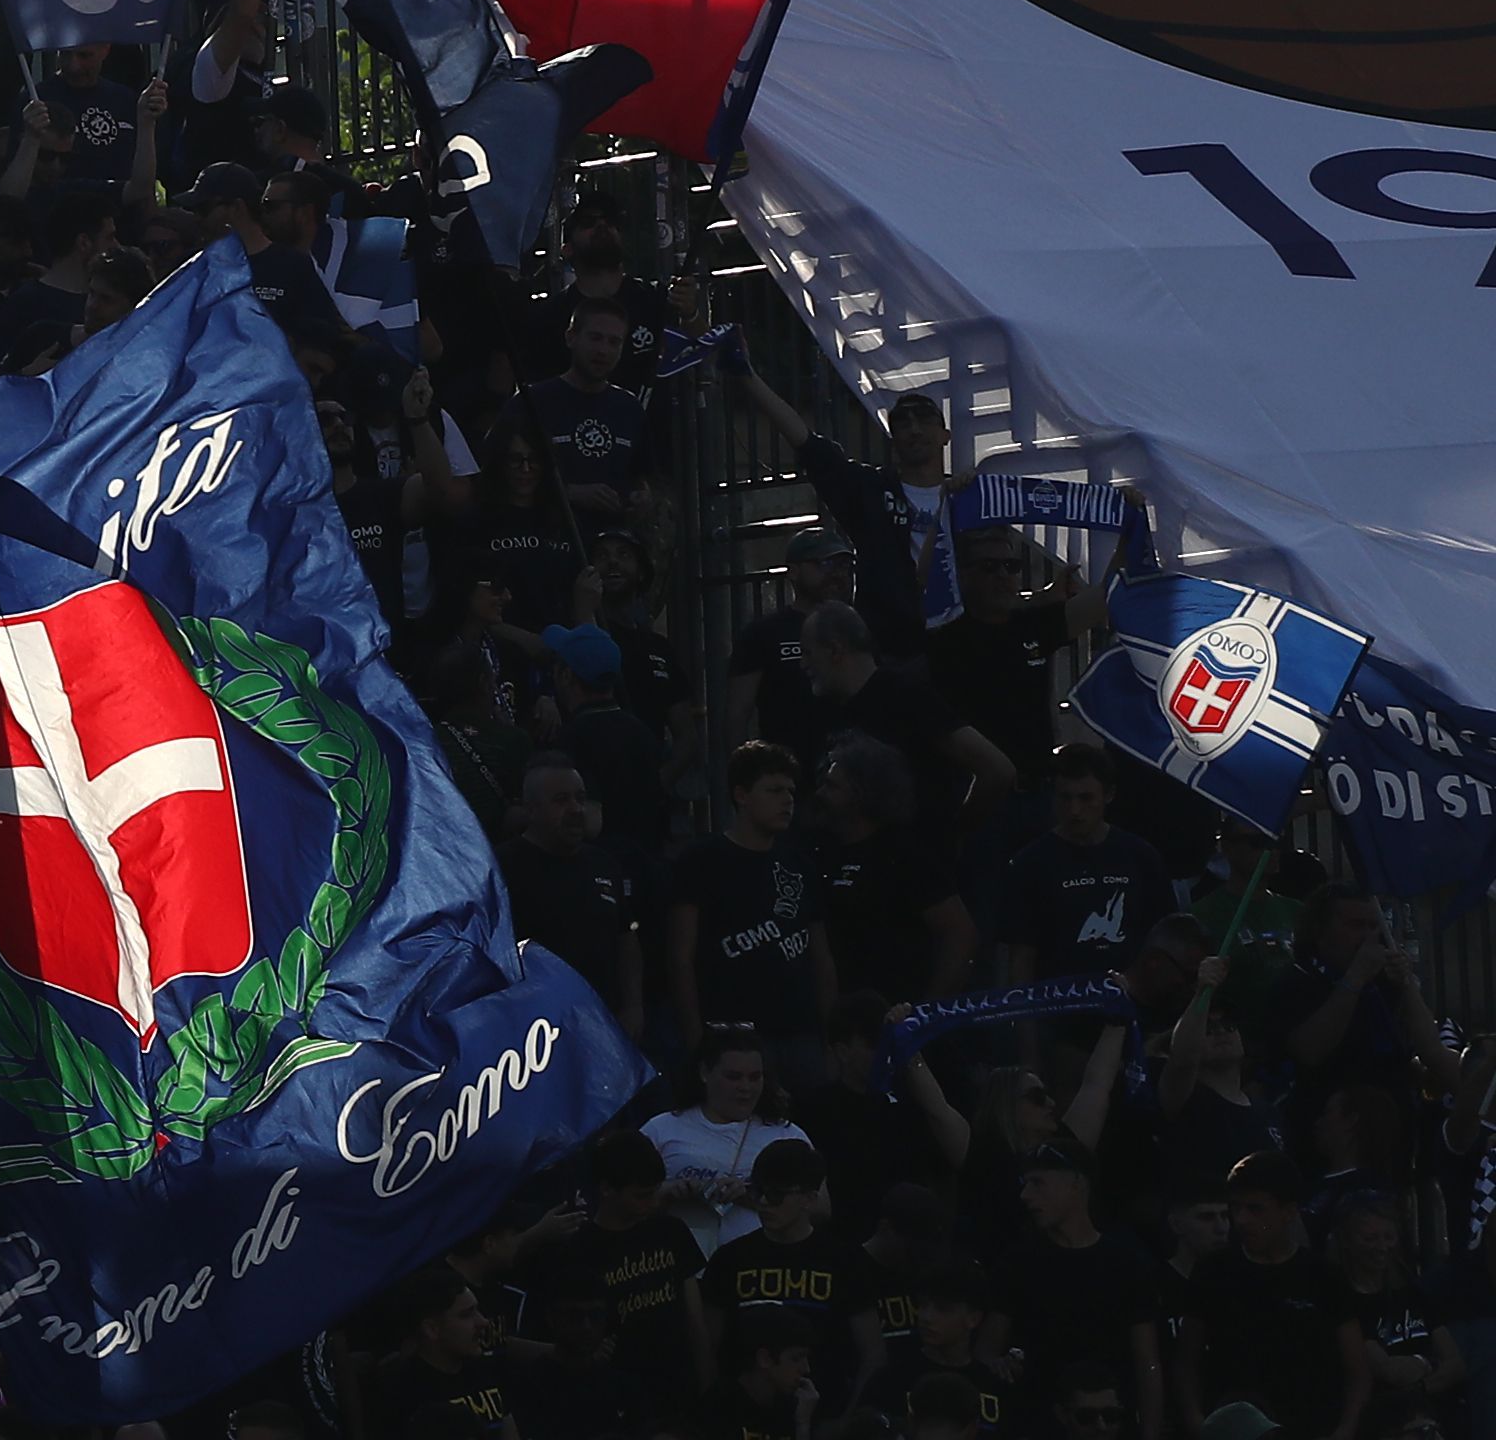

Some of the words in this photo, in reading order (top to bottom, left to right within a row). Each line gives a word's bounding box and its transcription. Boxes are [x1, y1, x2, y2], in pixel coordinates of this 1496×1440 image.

[978, 473, 1028, 519] 1907
[1065, 481, 1126, 526] COMO
[350, 524, 384, 539] OMO
[490, 535, 540, 552] COMO
[1375, 769, 1425, 823] DI
[1435, 772, 1496, 821] ST
[1061, 876, 1097, 888] CALCIO
[1102, 874, 1130, 886] COMO
[720, 921, 782, 959] COMO
[231, 1165, 301, 1280] di
[737, 1267, 832, 1301] COMO
